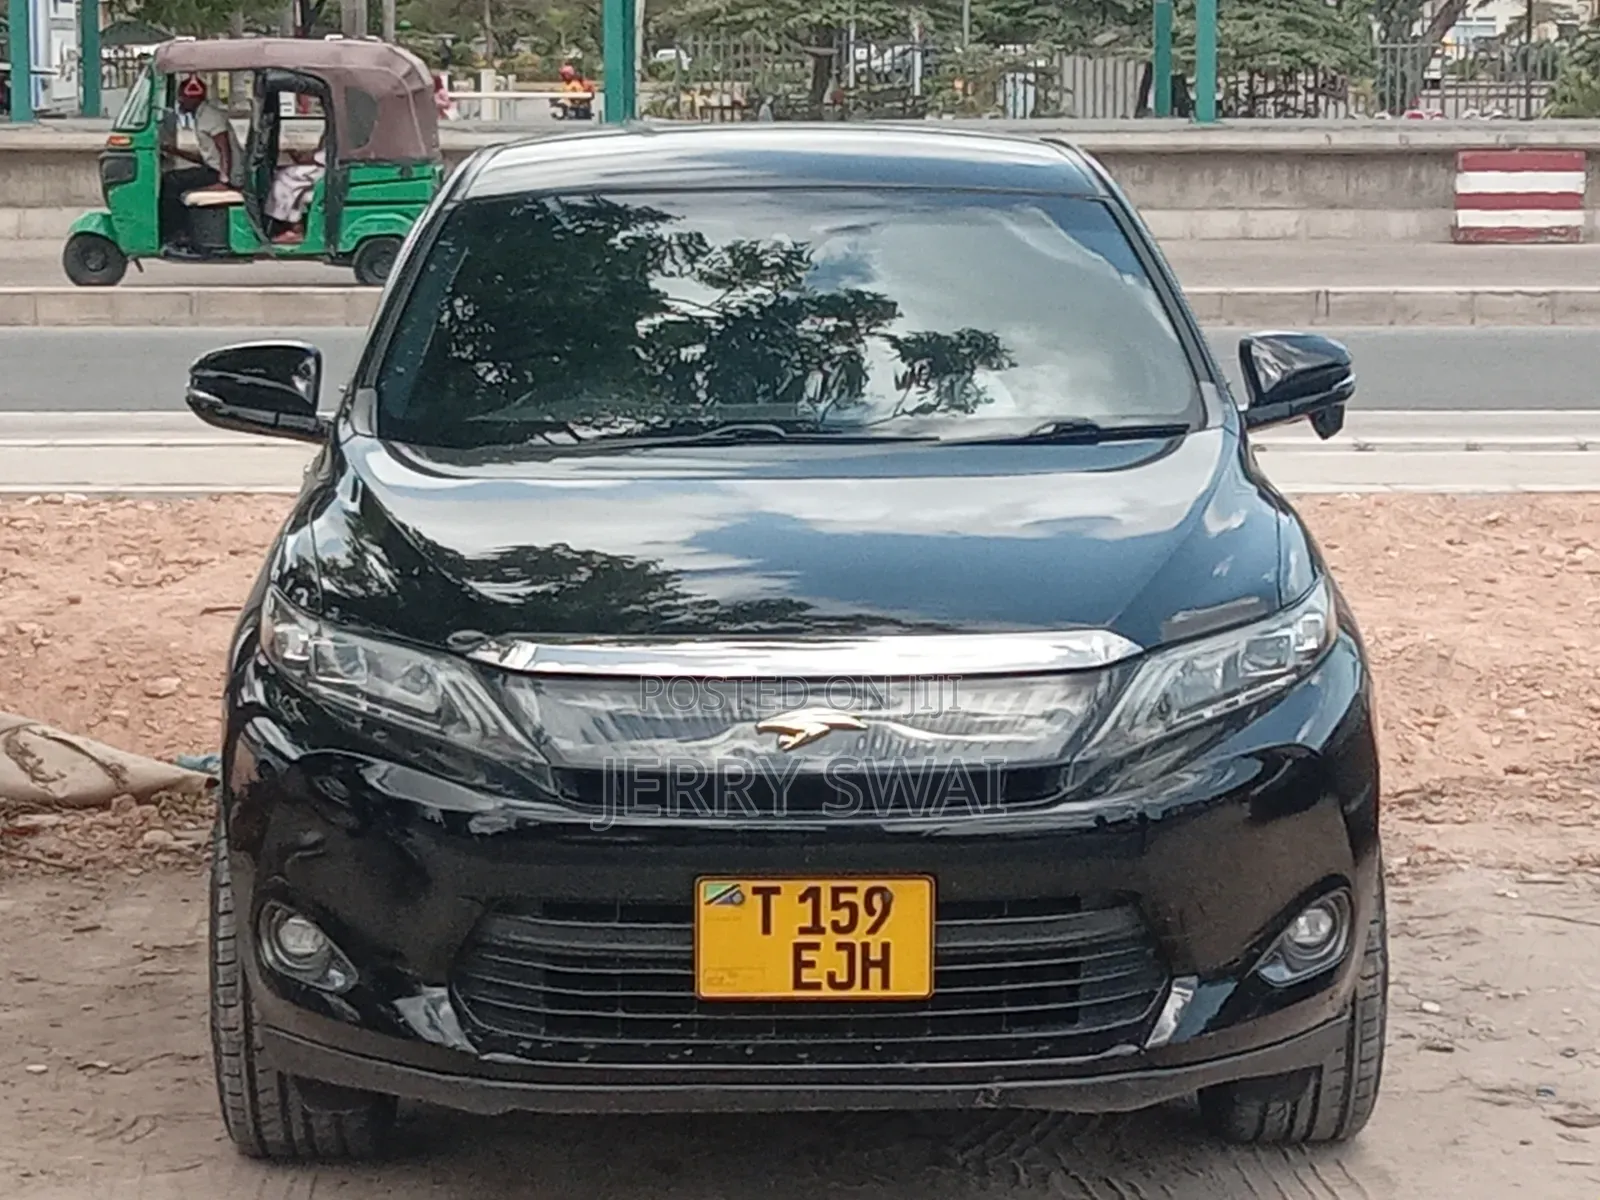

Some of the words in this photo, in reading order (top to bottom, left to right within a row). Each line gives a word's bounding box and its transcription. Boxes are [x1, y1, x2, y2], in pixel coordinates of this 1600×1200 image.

[752, 886, 781, 935] T
[798, 886, 893, 935] 159
[792, 941, 891, 990] EJH
